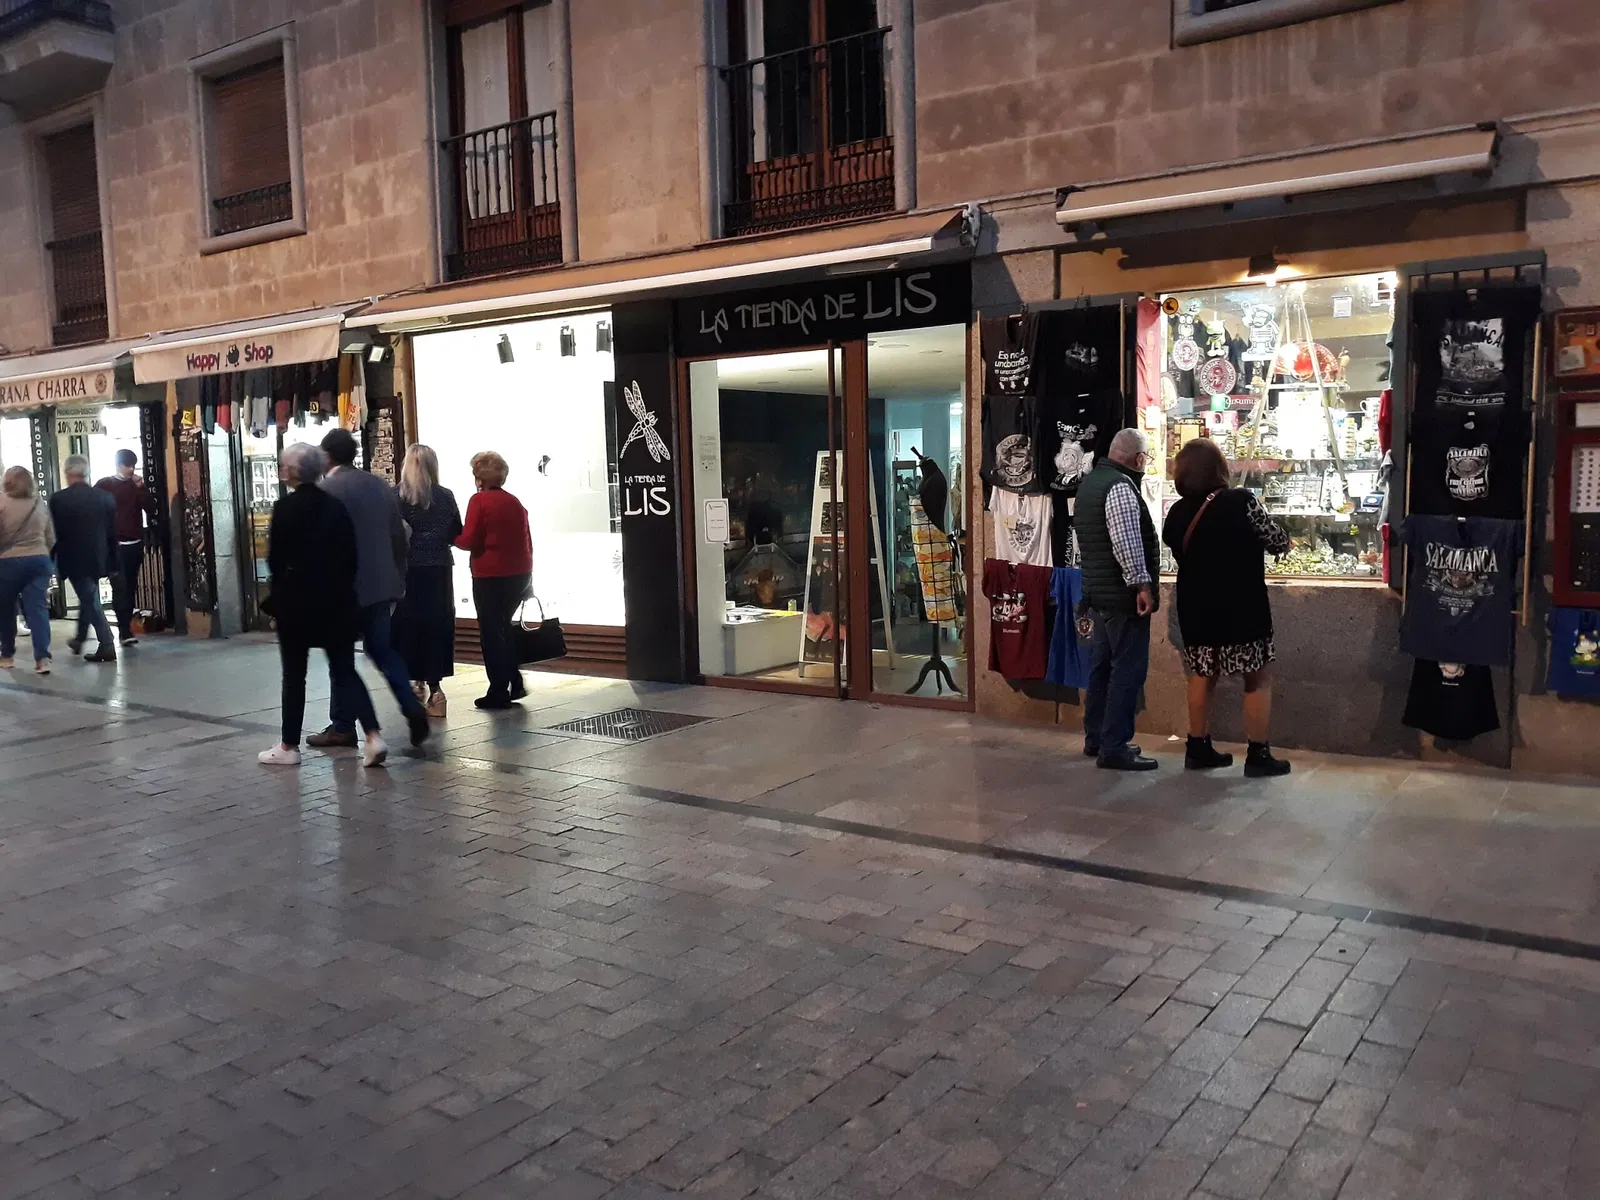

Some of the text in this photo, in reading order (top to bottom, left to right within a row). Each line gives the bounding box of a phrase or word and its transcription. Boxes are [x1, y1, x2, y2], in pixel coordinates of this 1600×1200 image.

[700, 271, 937, 344] LA TIENDA DE LIS
[186, 342, 274, 372] Happy Shop
[37, 376, 87, 401] CHARRA
[34, 418, 45, 487] PROMOCION
[624, 475, 666, 486] LA TIENDA DE
[624, 486, 671, 516] LIS
[1425, 542, 1499, 573] SALAMANCA
